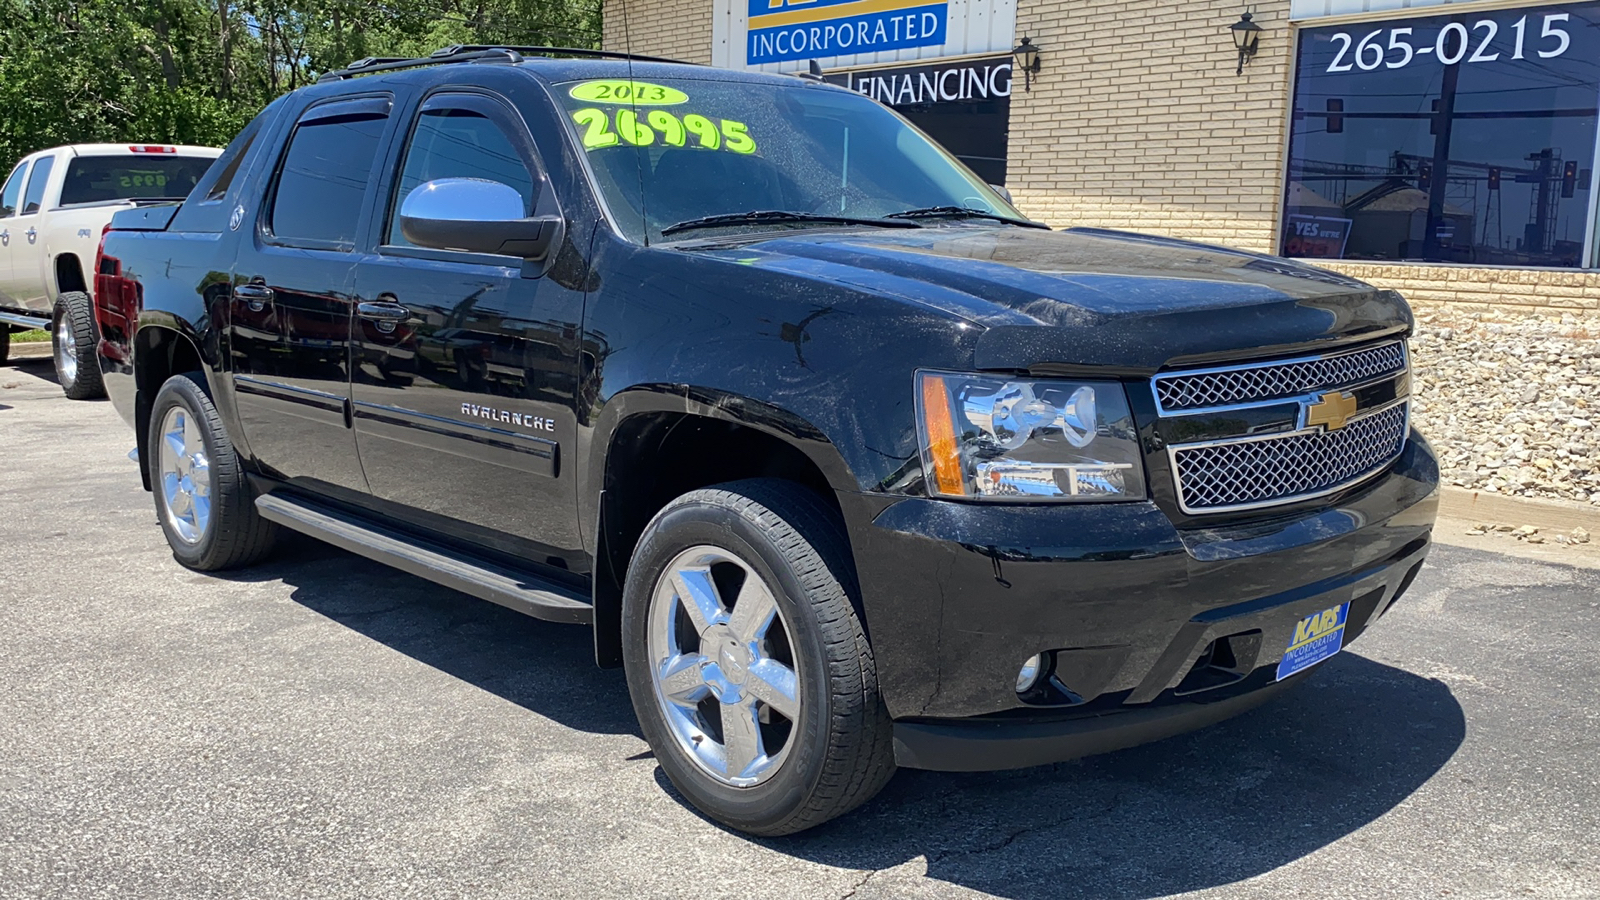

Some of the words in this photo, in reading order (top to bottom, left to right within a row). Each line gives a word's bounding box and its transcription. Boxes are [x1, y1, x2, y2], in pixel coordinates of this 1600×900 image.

[753, 12, 938, 57] INCORPORATED
[1326, 13, 1570, 72] 265-0215
[595, 85, 666, 100] 2013
[858, 64, 1012, 105] FINANCING
[573, 108, 757, 154] 26995
[1295, 221, 1319, 236] YES
[461, 402, 555, 432] AVALANCHE
[1292, 604, 1341, 645] KARS
[1286, 631, 1338, 661] INCORPORATED
